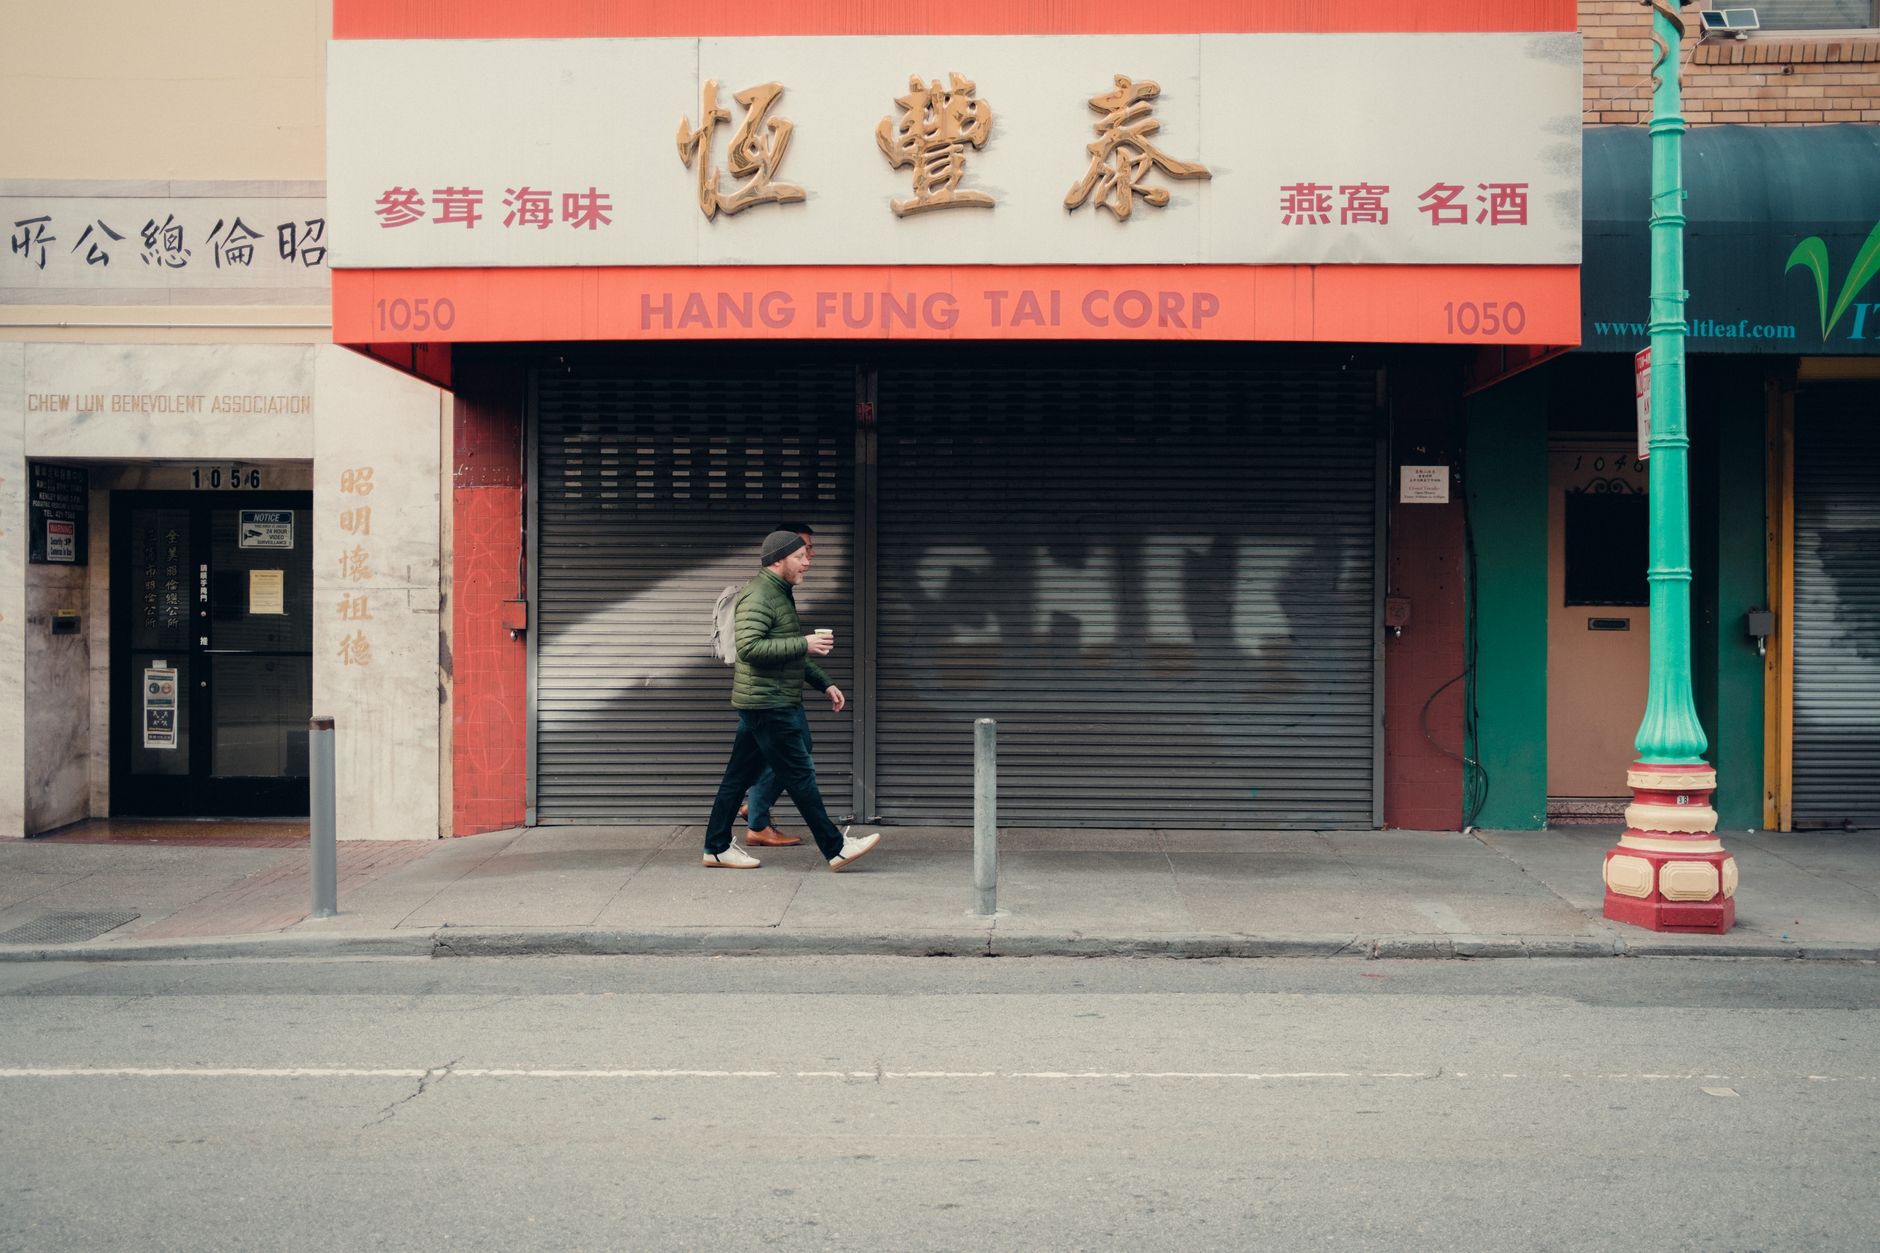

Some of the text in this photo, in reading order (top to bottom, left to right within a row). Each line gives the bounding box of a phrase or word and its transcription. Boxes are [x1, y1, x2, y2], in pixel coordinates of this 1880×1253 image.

[502, 186, 613, 230] 海味
[1280, 182, 1529, 226] 燕窩 名酒
[376, 298, 456, 331] 1050
[640, 289, 1220, 331] HANG FUNG TAI CORP
[1443, 300, 1526, 336] 1050
[28, 394, 311, 414] CHEW LUN BENEVOLENT ASSOCIATION
[192, 469, 260, 489] 1056
[253, 513, 281, 522] NOTICE
